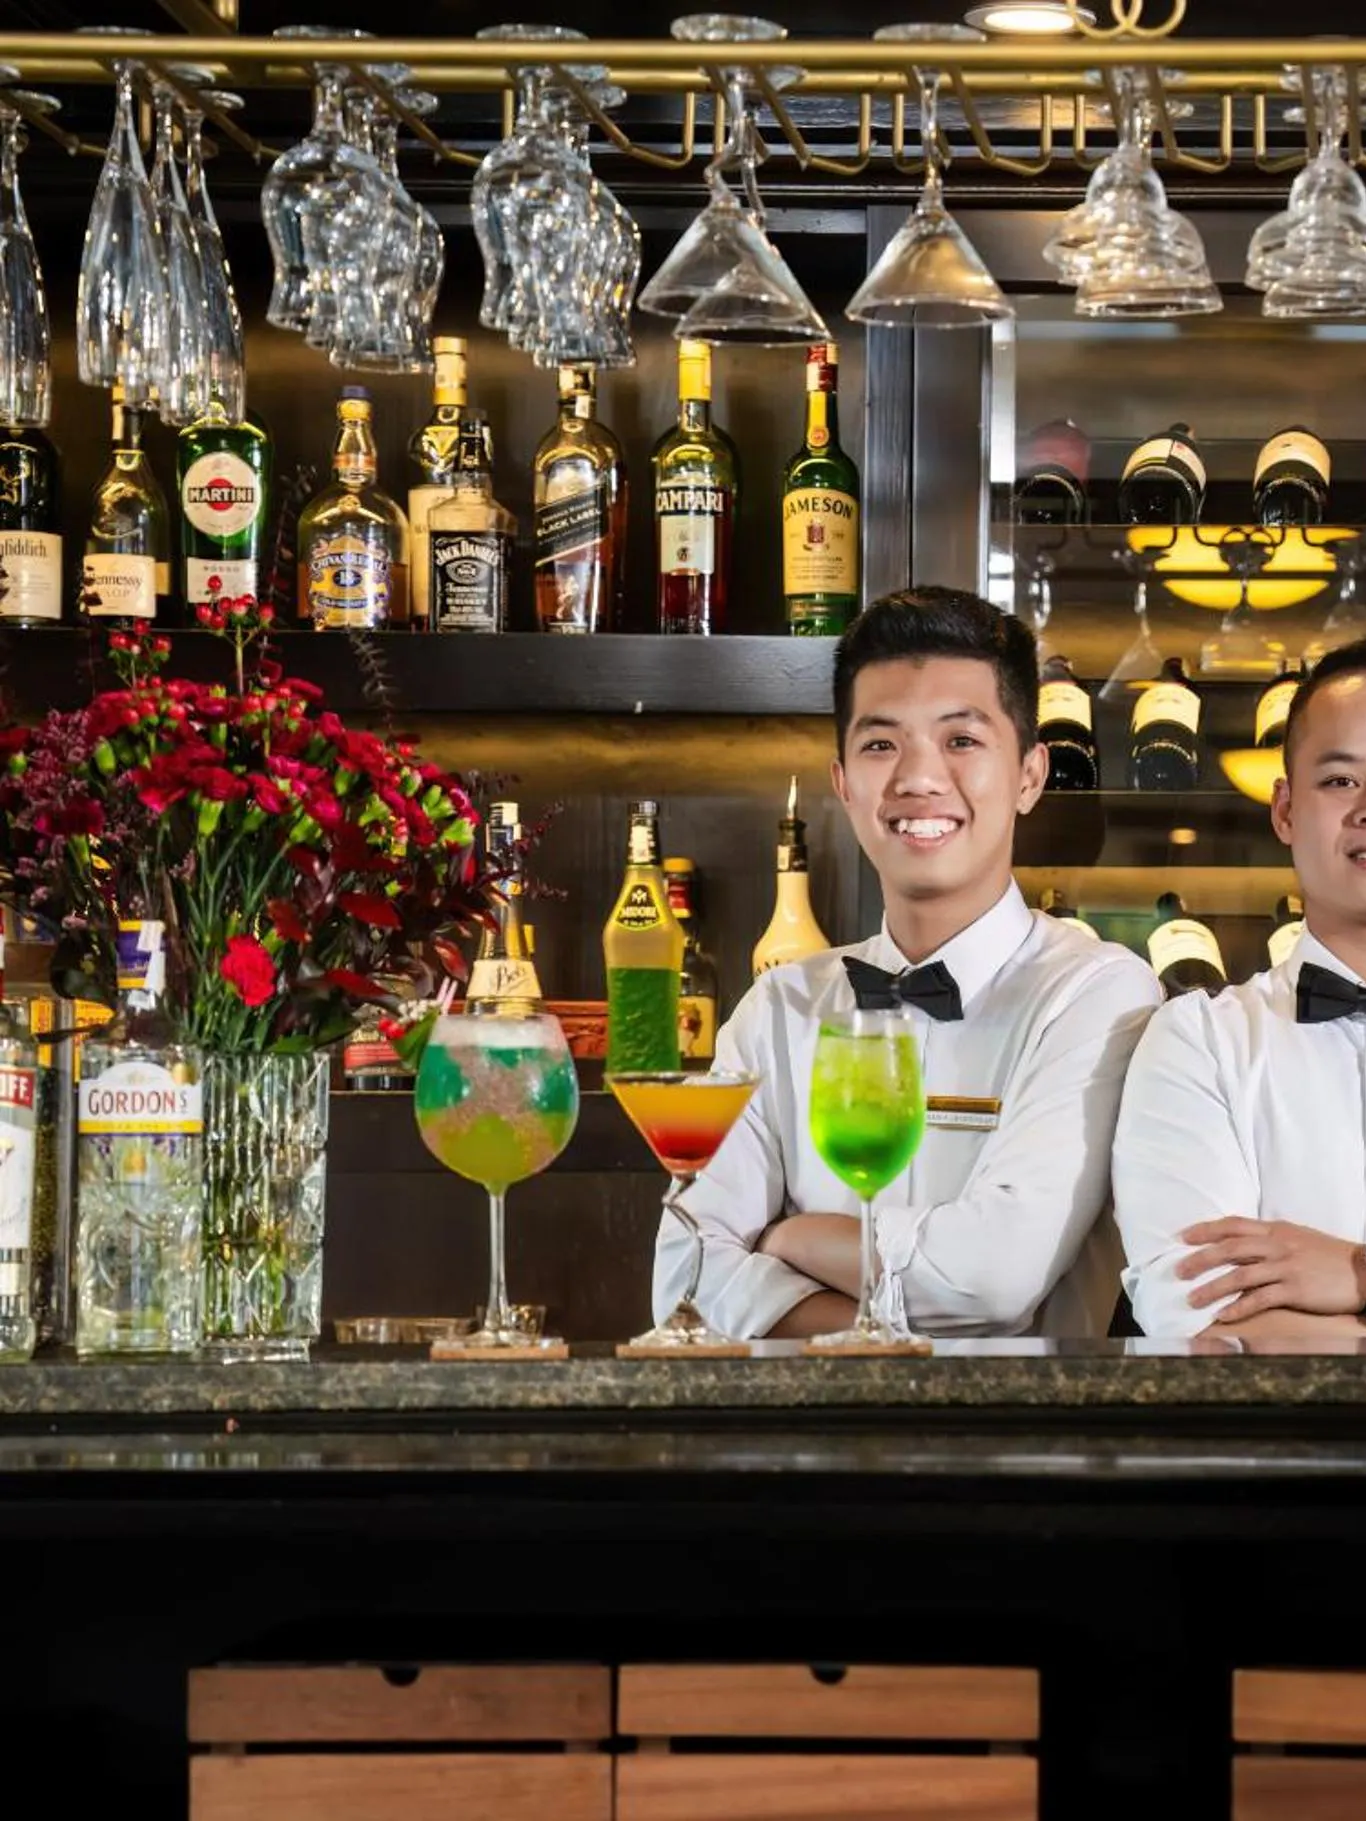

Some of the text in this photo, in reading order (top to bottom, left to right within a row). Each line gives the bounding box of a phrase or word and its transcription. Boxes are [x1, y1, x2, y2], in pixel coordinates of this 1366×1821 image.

[189, 488, 253, 502] MARTINI
[656, 490, 724, 512] CAMPARI
[784, 496, 854, 520] JAMESON
[537, 518, 569, 537] BLACK
[570, 508, 602, 524] LABEL
[435, 543, 461, 567] JACK
